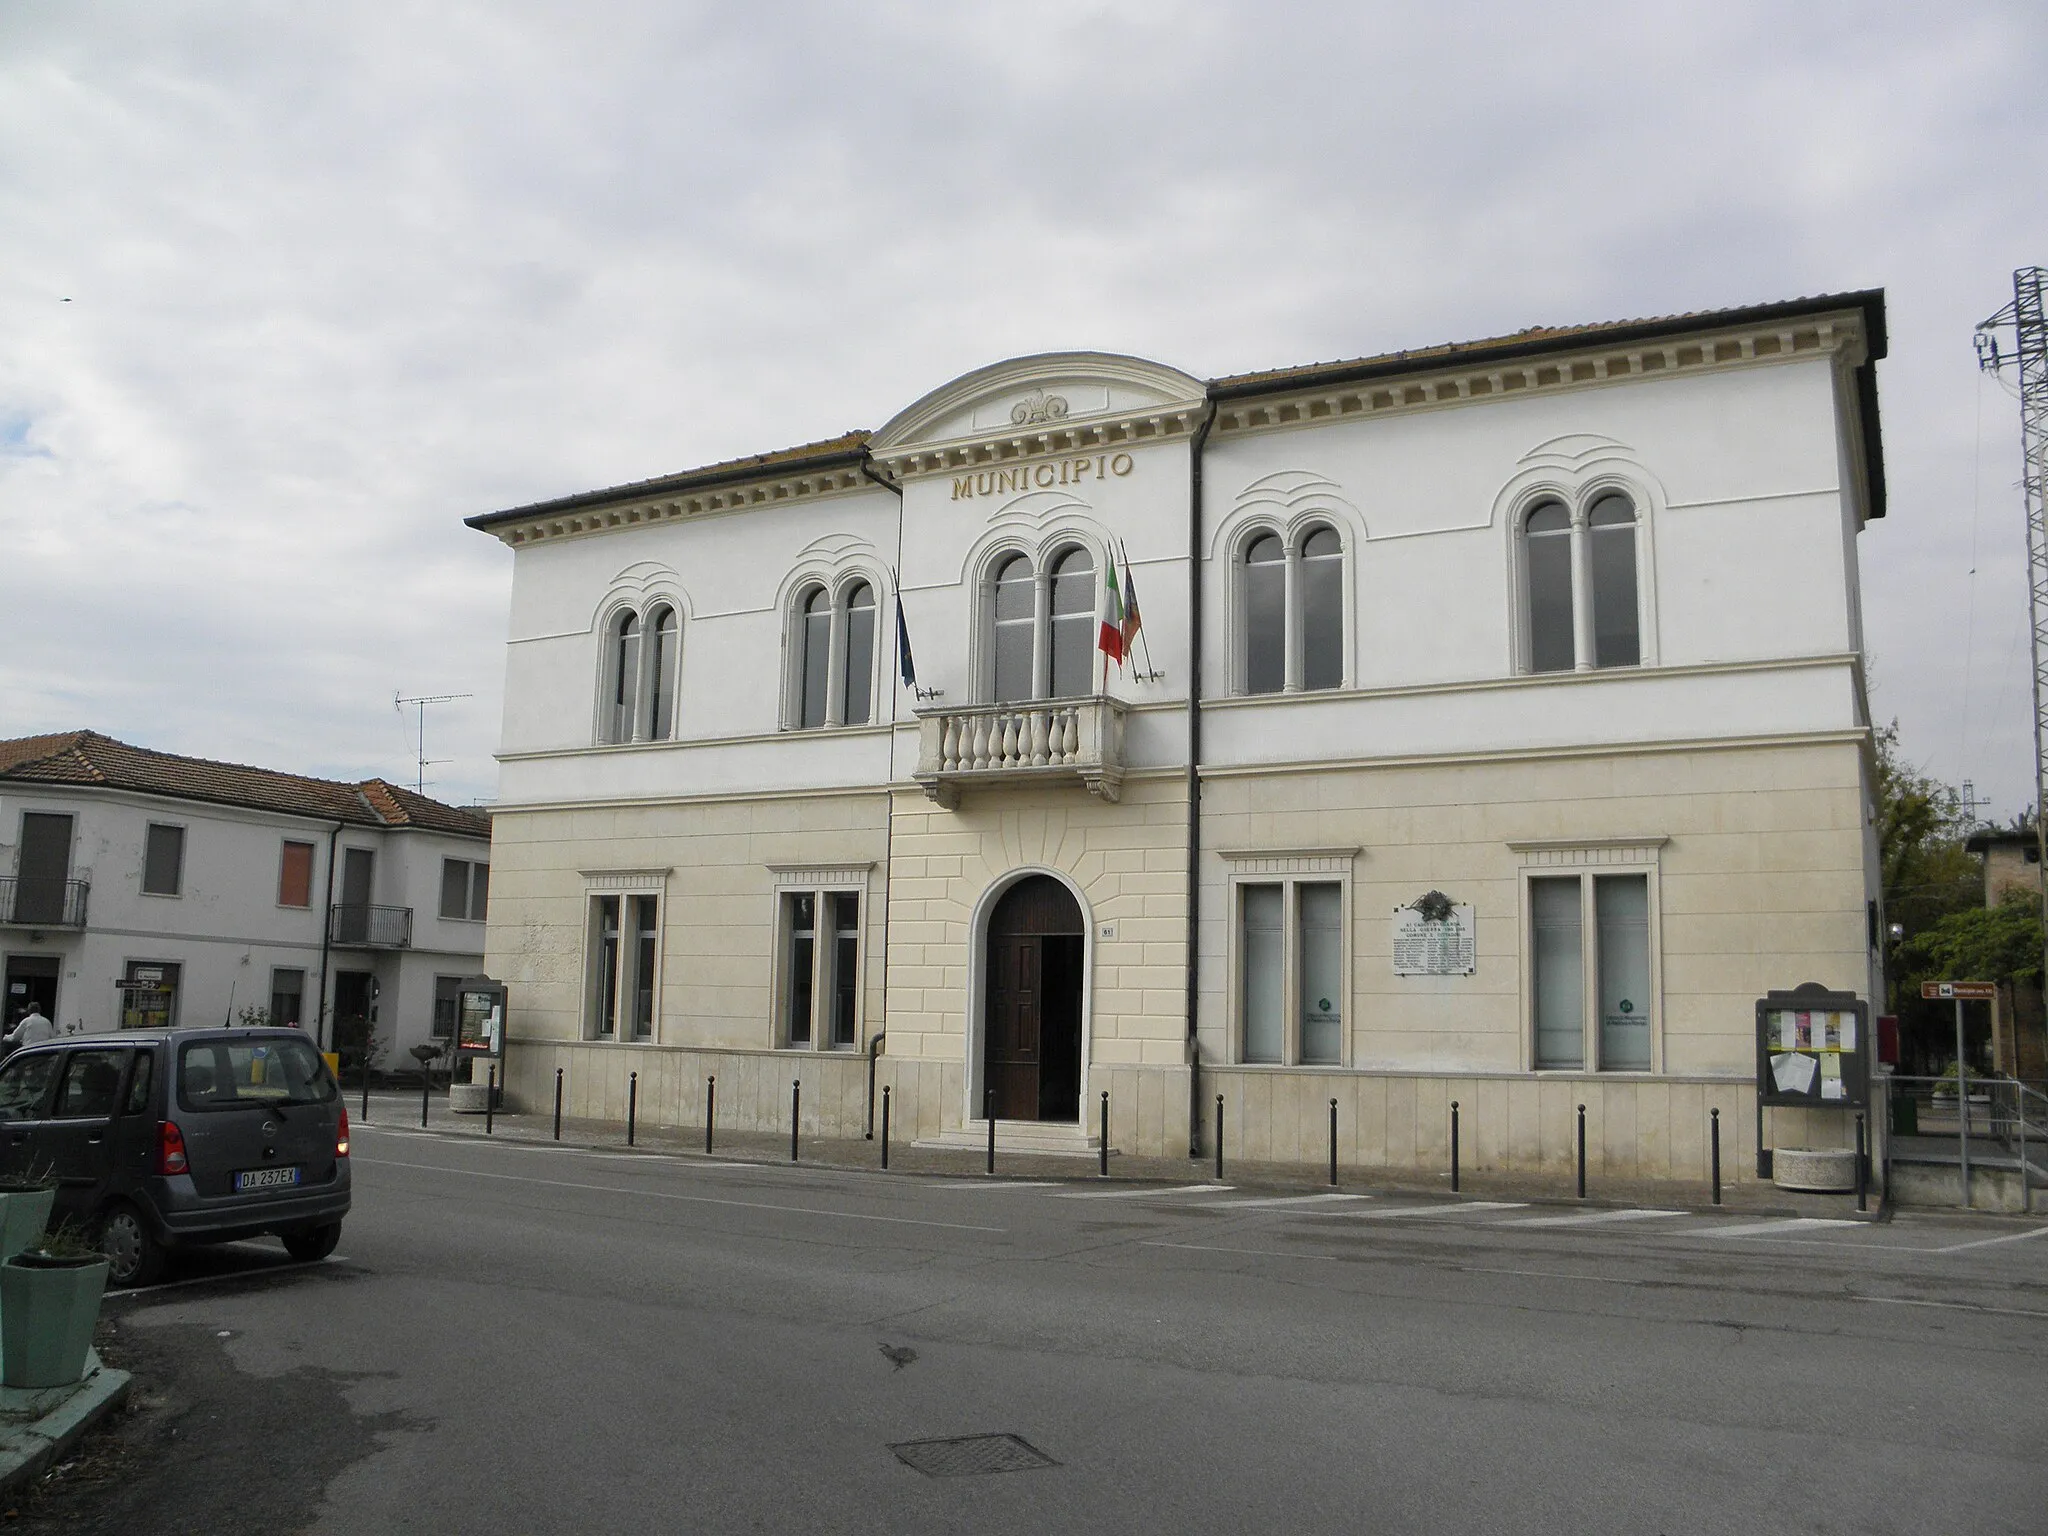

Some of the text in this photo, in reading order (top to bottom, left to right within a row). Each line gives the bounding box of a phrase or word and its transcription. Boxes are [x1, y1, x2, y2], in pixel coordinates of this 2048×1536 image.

[950, 452, 1134, 501] MUNICIPIO
[243, 1168, 294, 1187] DA 237EX
